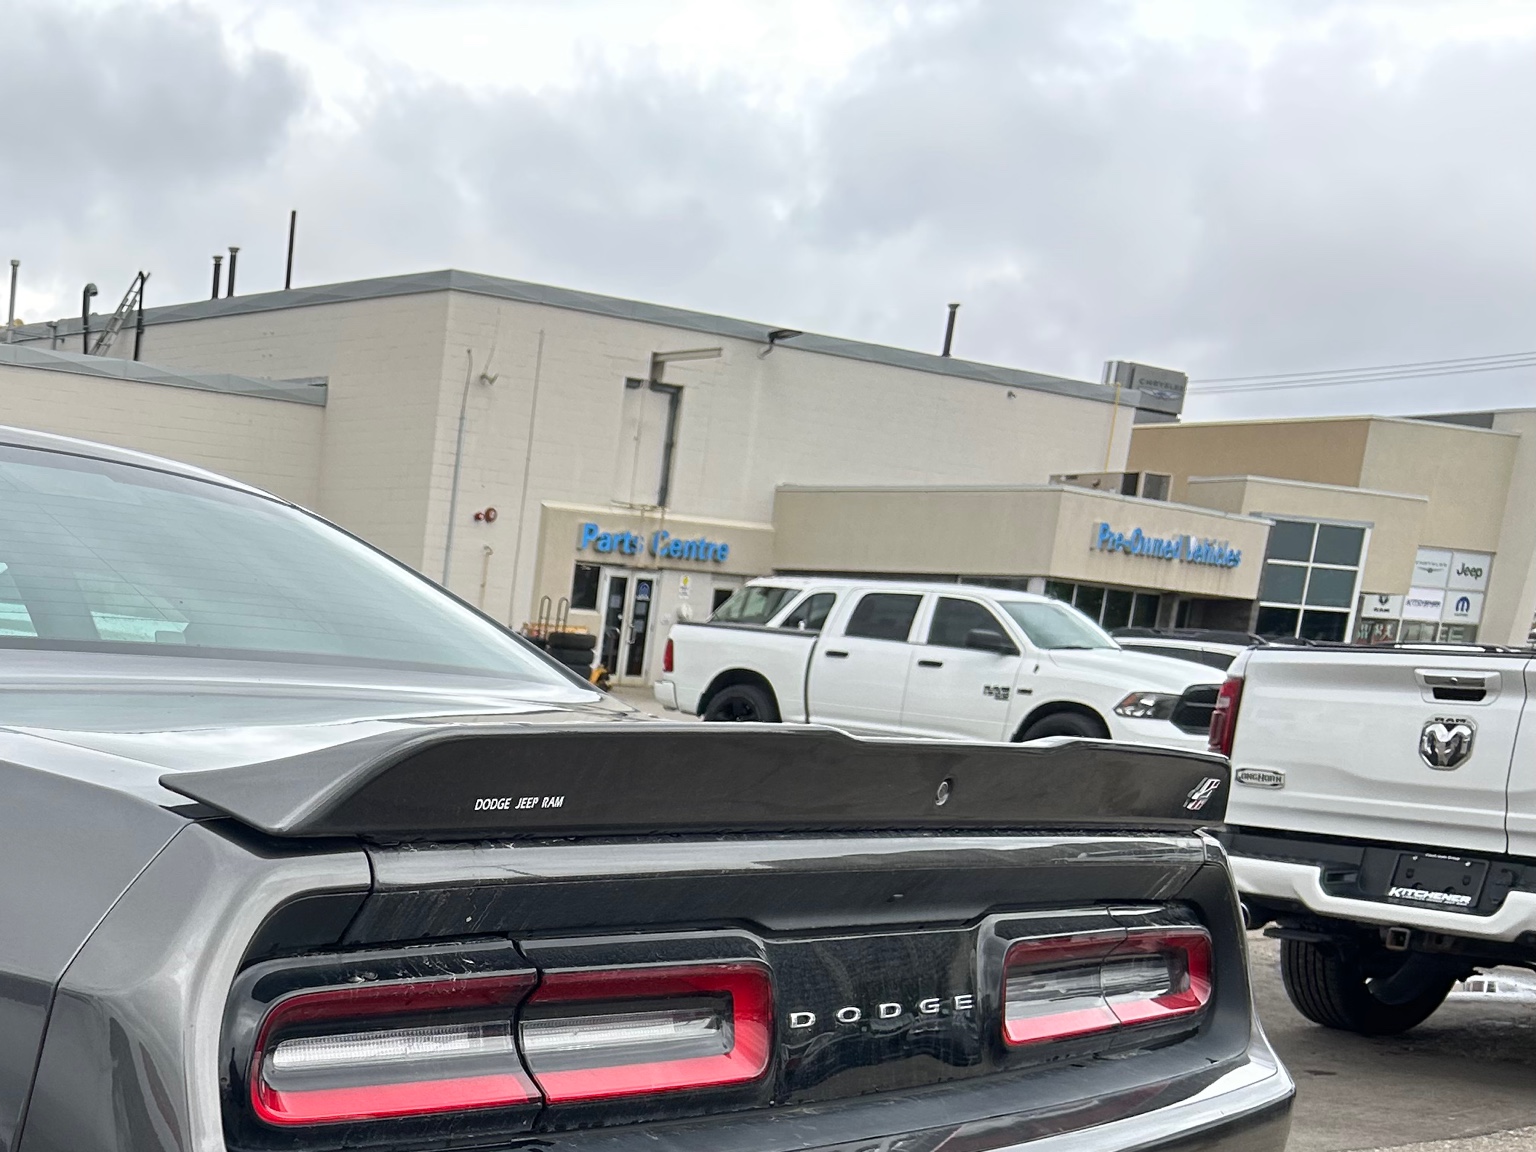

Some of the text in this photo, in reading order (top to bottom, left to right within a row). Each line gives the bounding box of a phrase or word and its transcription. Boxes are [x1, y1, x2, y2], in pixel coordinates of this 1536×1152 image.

[579, 522, 729, 562] Parts Centre
[1096, 522, 1182, 560] Pre-Owned
[1456, 562, 1483, 580] Jeep
[474, 795, 565, 811] DODGE JEEP RAM
[1388, 886, 1471, 903] KITCHENER
[789, 994, 973, 1029] DODGE
